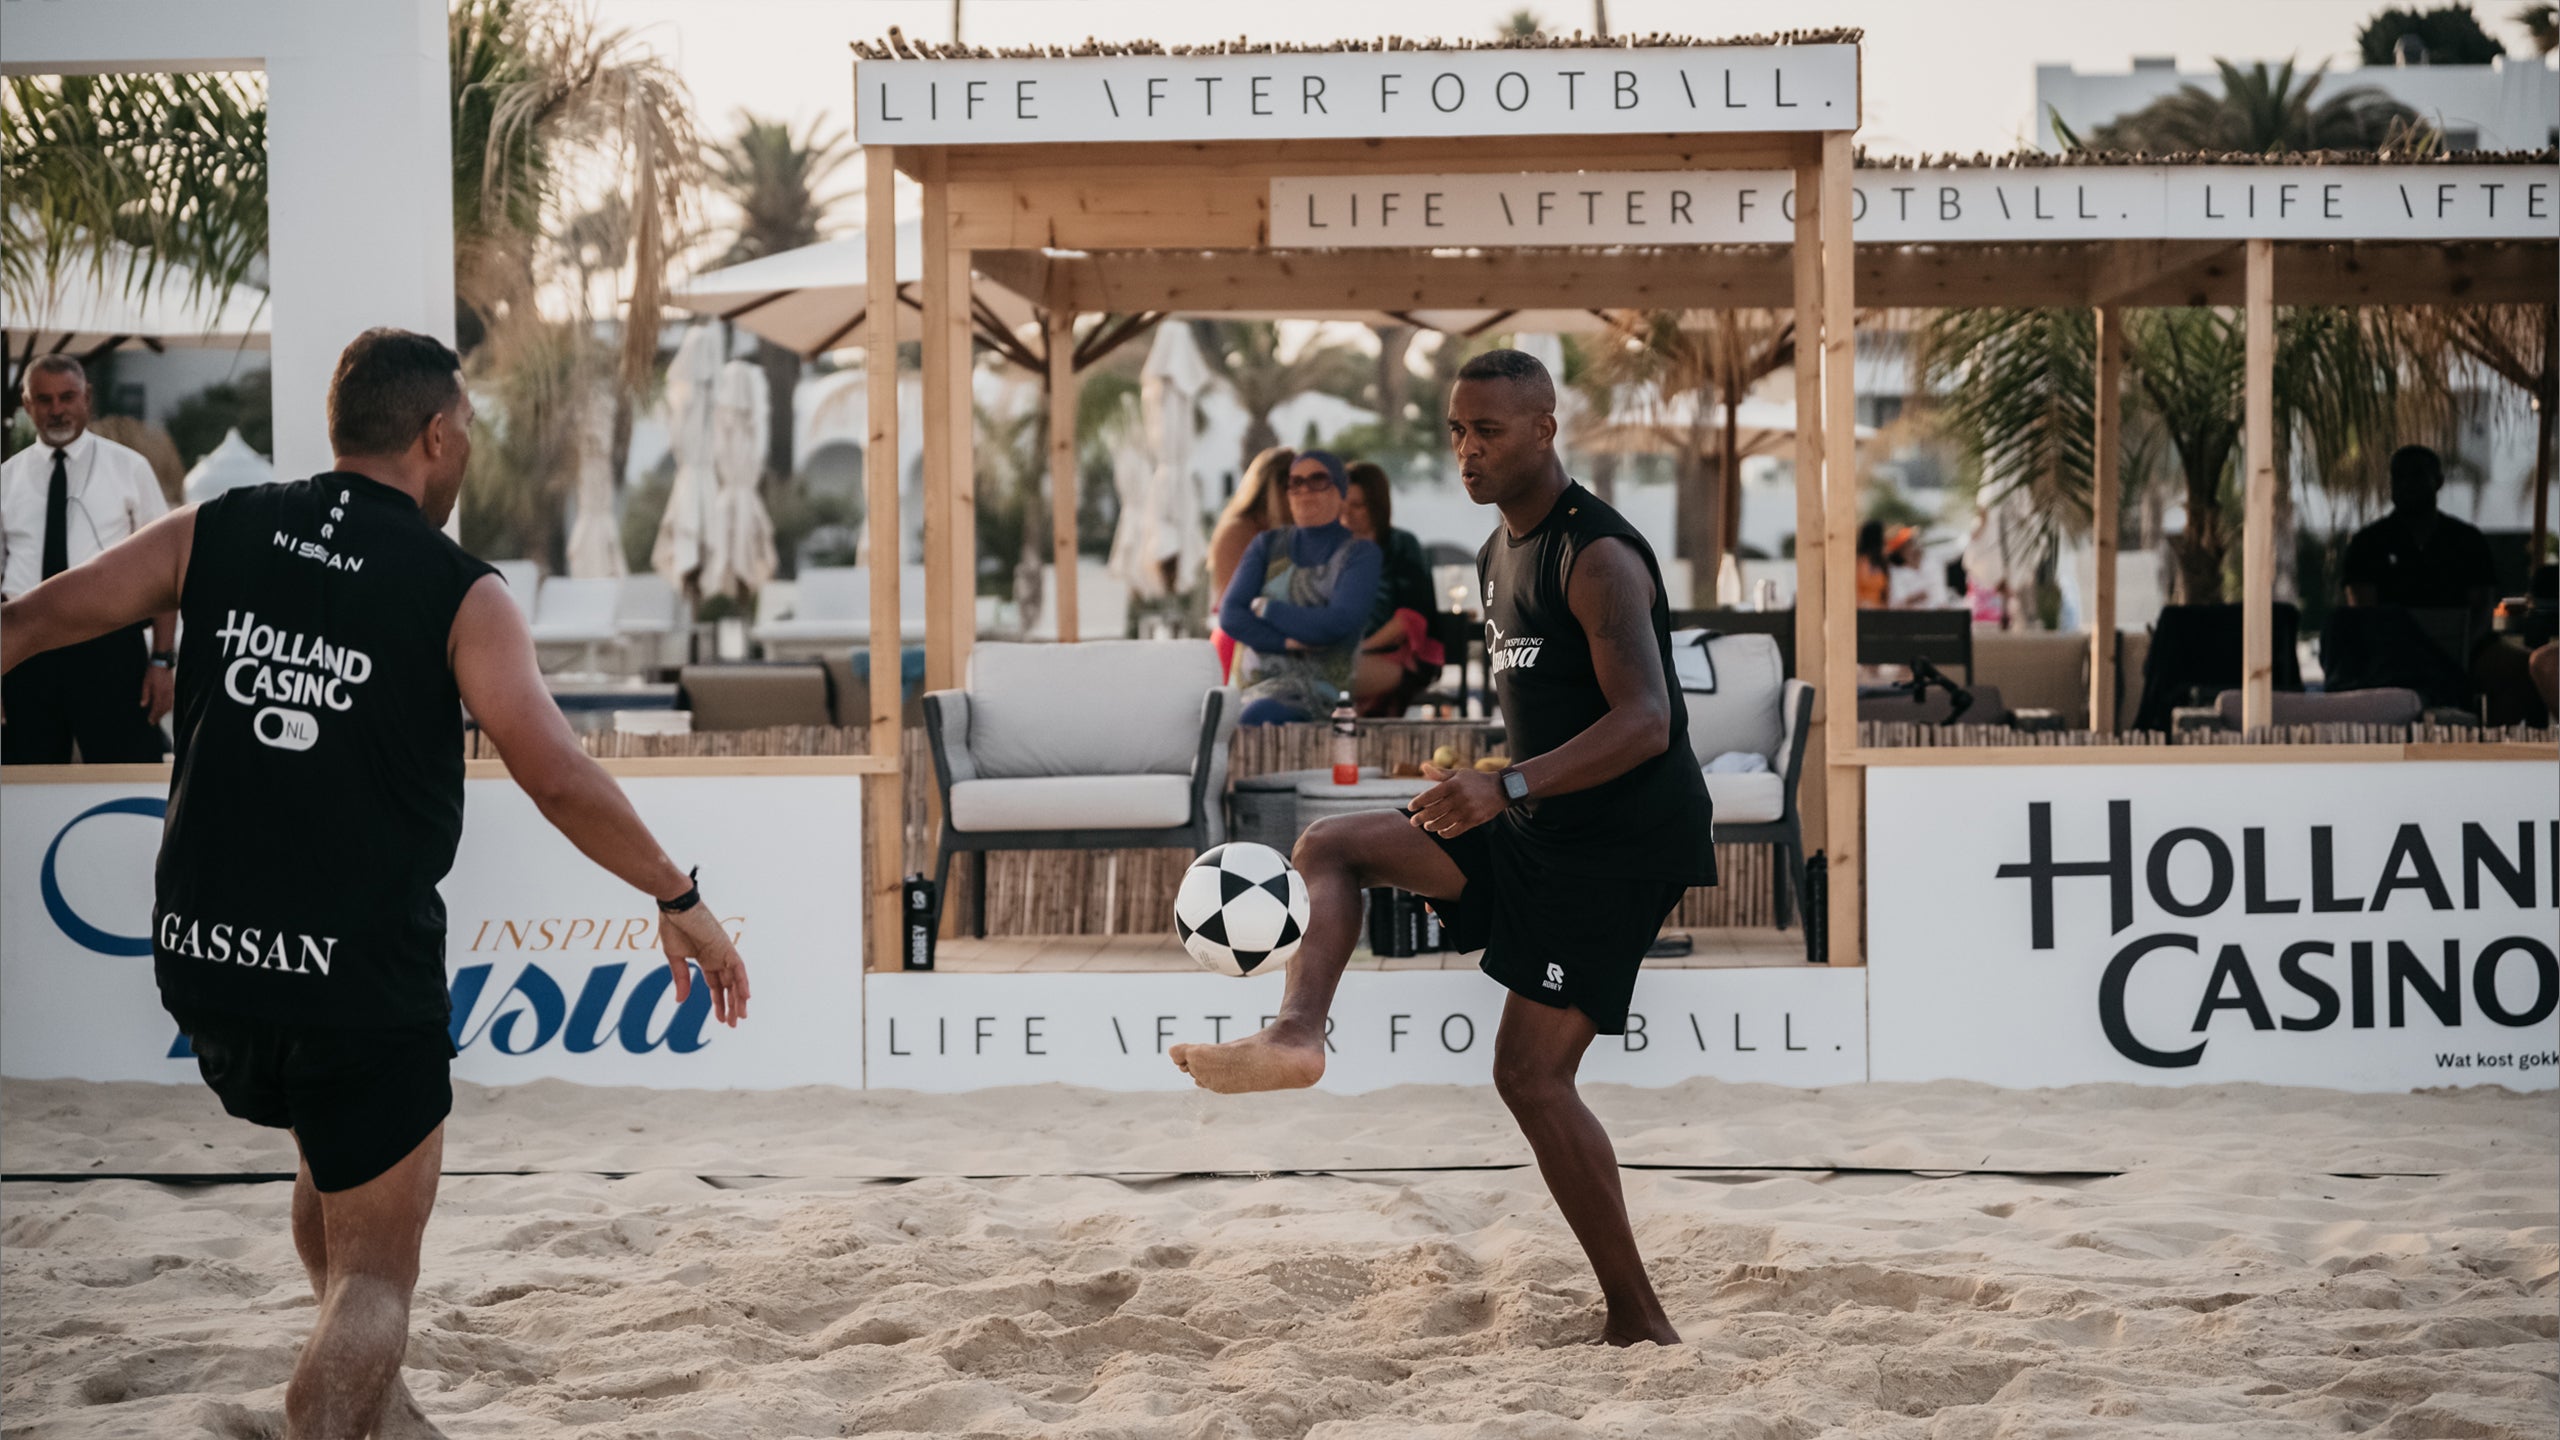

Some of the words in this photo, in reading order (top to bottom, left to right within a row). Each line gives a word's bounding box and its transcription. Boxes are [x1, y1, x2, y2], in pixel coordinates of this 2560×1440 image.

[880, 79, 1040, 122] LIFE
[1308, 192, 1445, 228] LIFE
[2205, 183, 2343, 219] LIFE
[272, 530, 364, 573] NISSAN
[215, 609, 373, 685] HOLLAND
[160, 911, 339, 976] GASSAN
[466, 915, 747, 952] INSPIR
[2097, 932, 2559, 1069] CASINO
[889, 1016, 1047, 1056] LIFE
[2434, 1051, 2472, 1069] Wat
[2476, 1050, 2514, 1069] kost
